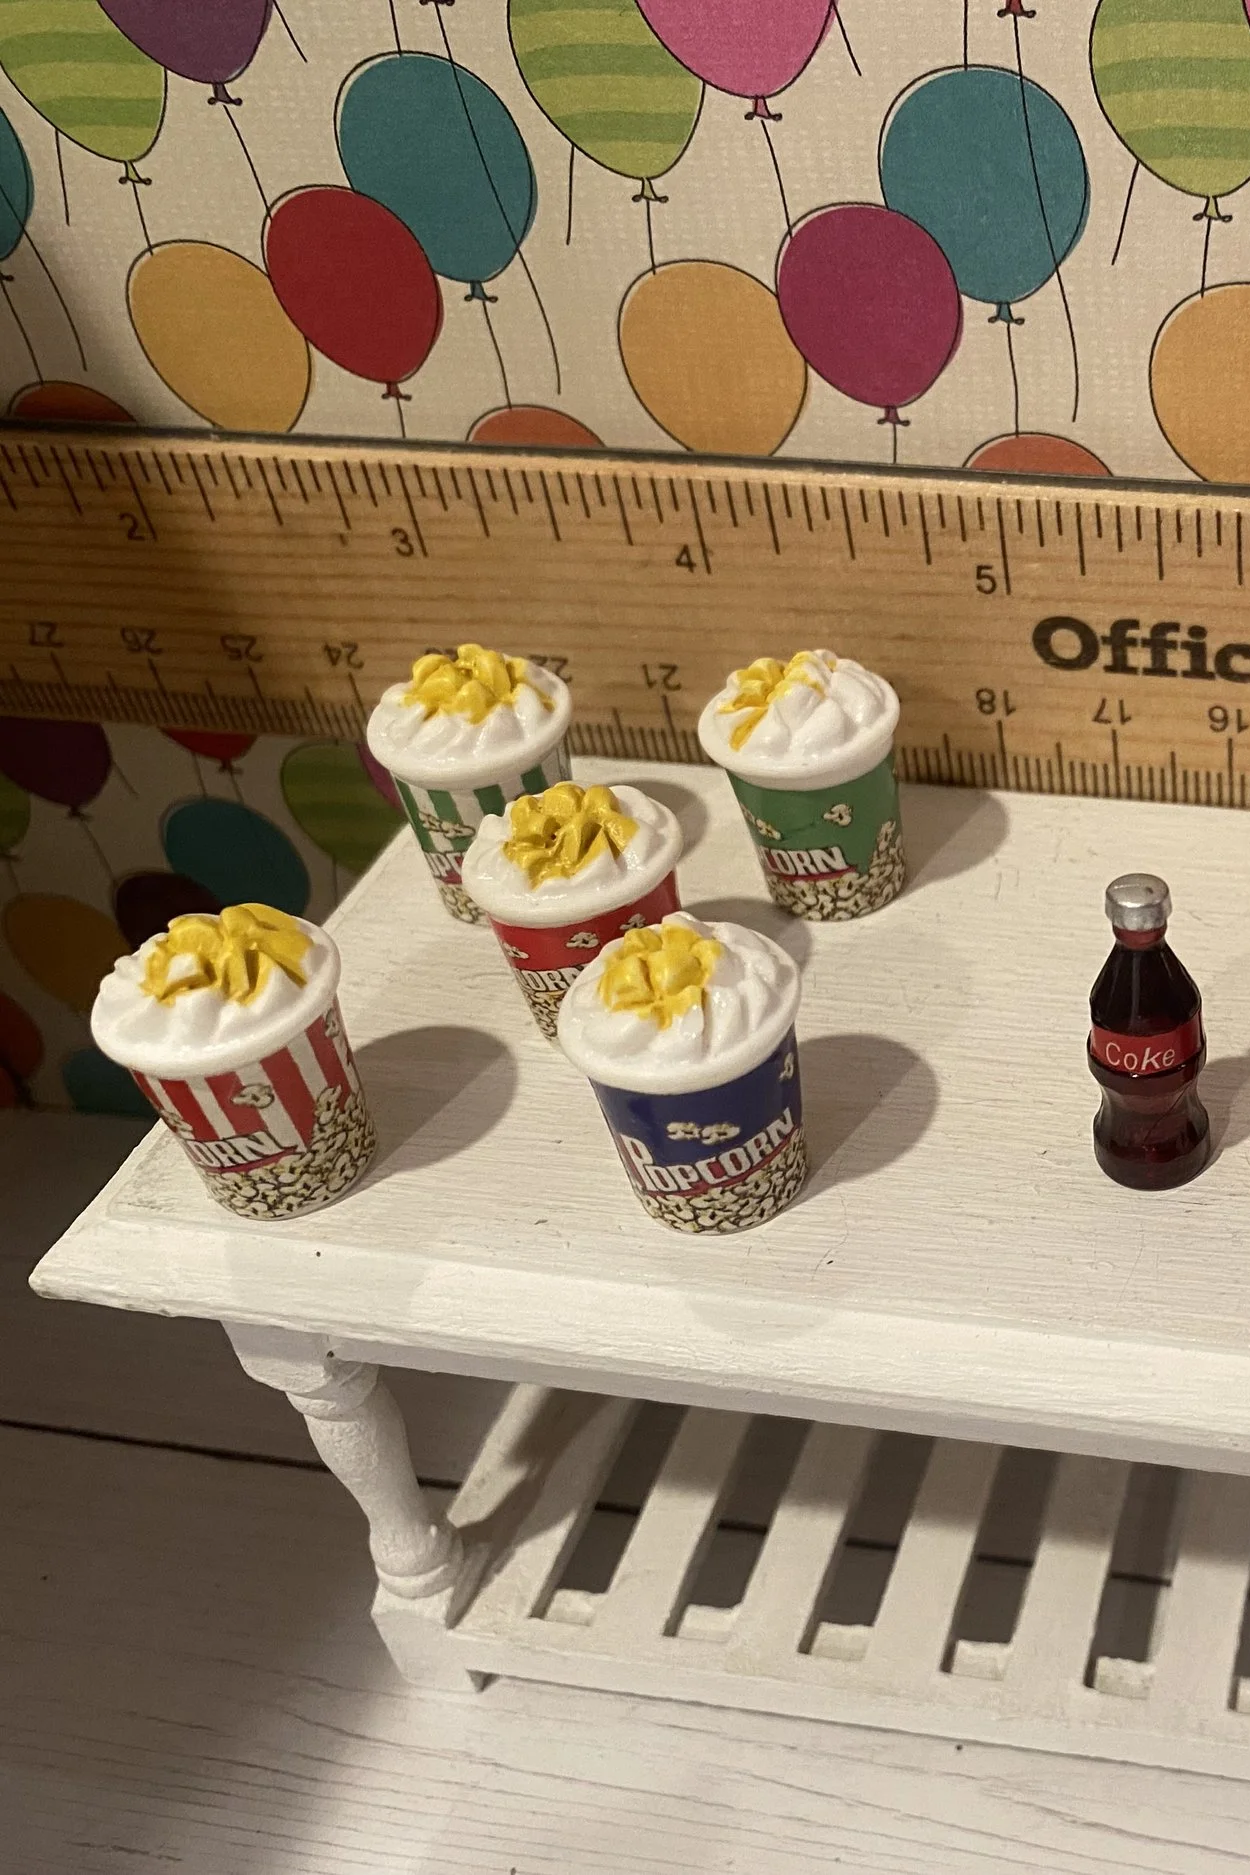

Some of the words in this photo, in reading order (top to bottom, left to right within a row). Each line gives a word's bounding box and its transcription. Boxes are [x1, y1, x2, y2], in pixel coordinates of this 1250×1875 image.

[119, 512, 147, 541] 2
[391, 527, 414, 558] 3
[675, 543, 698, 573] 4
[975, 564, 997, 594] 5
[121, 627, 163, 656] 26
[220, 634, 264, 662] 25
[325, 641, 364, 670] 24
[642, 662, 682, 692] 21
[976, 688, 1017, 716] 18
[1092, 697, 1132, 726] 17
[1209, 705, 1250, 735] 16
[1105, 1041, 1176, 1072] Coke
[619, 1106, 796, 1193] POPCORN
